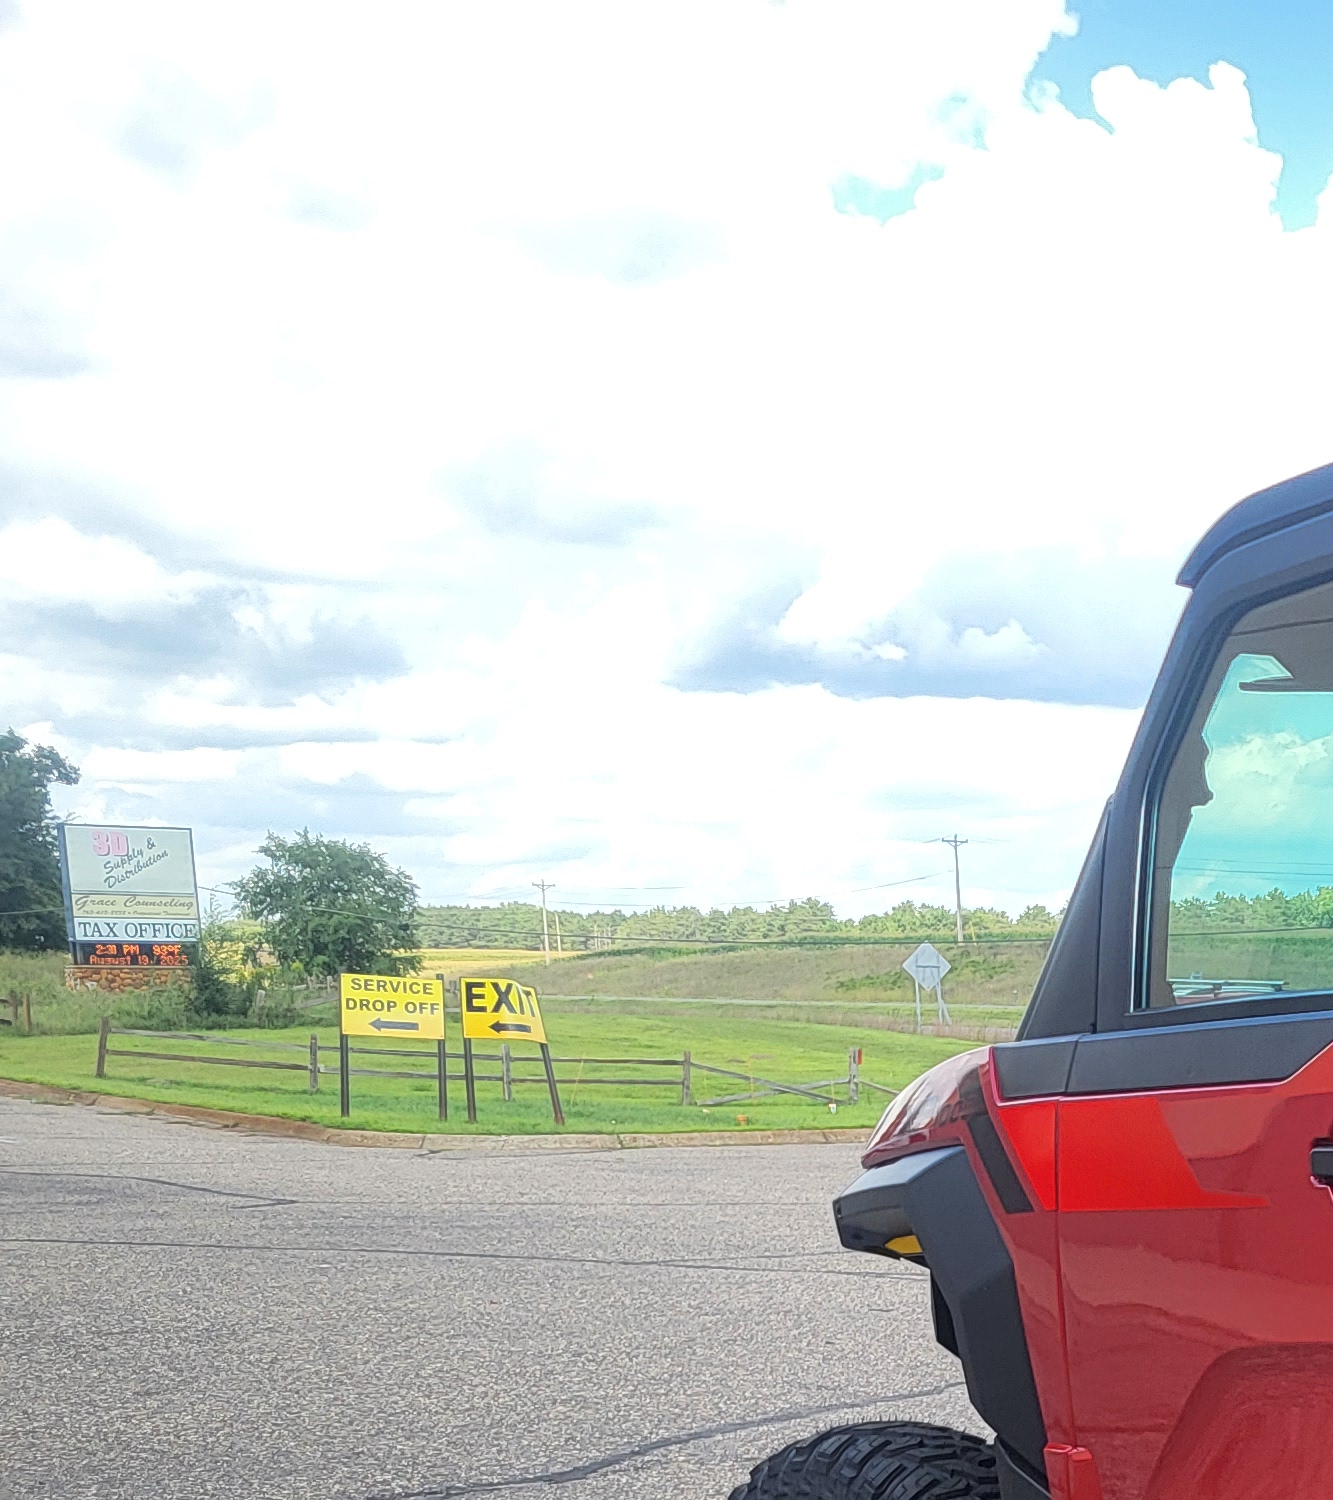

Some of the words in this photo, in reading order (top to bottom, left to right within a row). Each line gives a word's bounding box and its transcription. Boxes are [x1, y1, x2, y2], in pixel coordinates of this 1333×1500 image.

[91, 831, 129, 857] 3D
[103, 848, 144, 875] Supply
[146, 837, 157, 850] &
[103, 849, 169, 889] Distribution
[75, 896, 118, 911] Grace
[124, 896, 194, 911] Counseling
[78, 921, 119, 938] TAX
[124, 922, 197, 939] OFFICE
[122, 944, 140, 955] PM
[90, 955, 131, 965] August
[160, 955, 189, 966] 2025
[350, 978, 434, 996] SERVICE
[345, 998, 398, 1013] DROP
[404, 1001, 440, 1016] OFF
[465, 981, 537, 1018] EXIT
